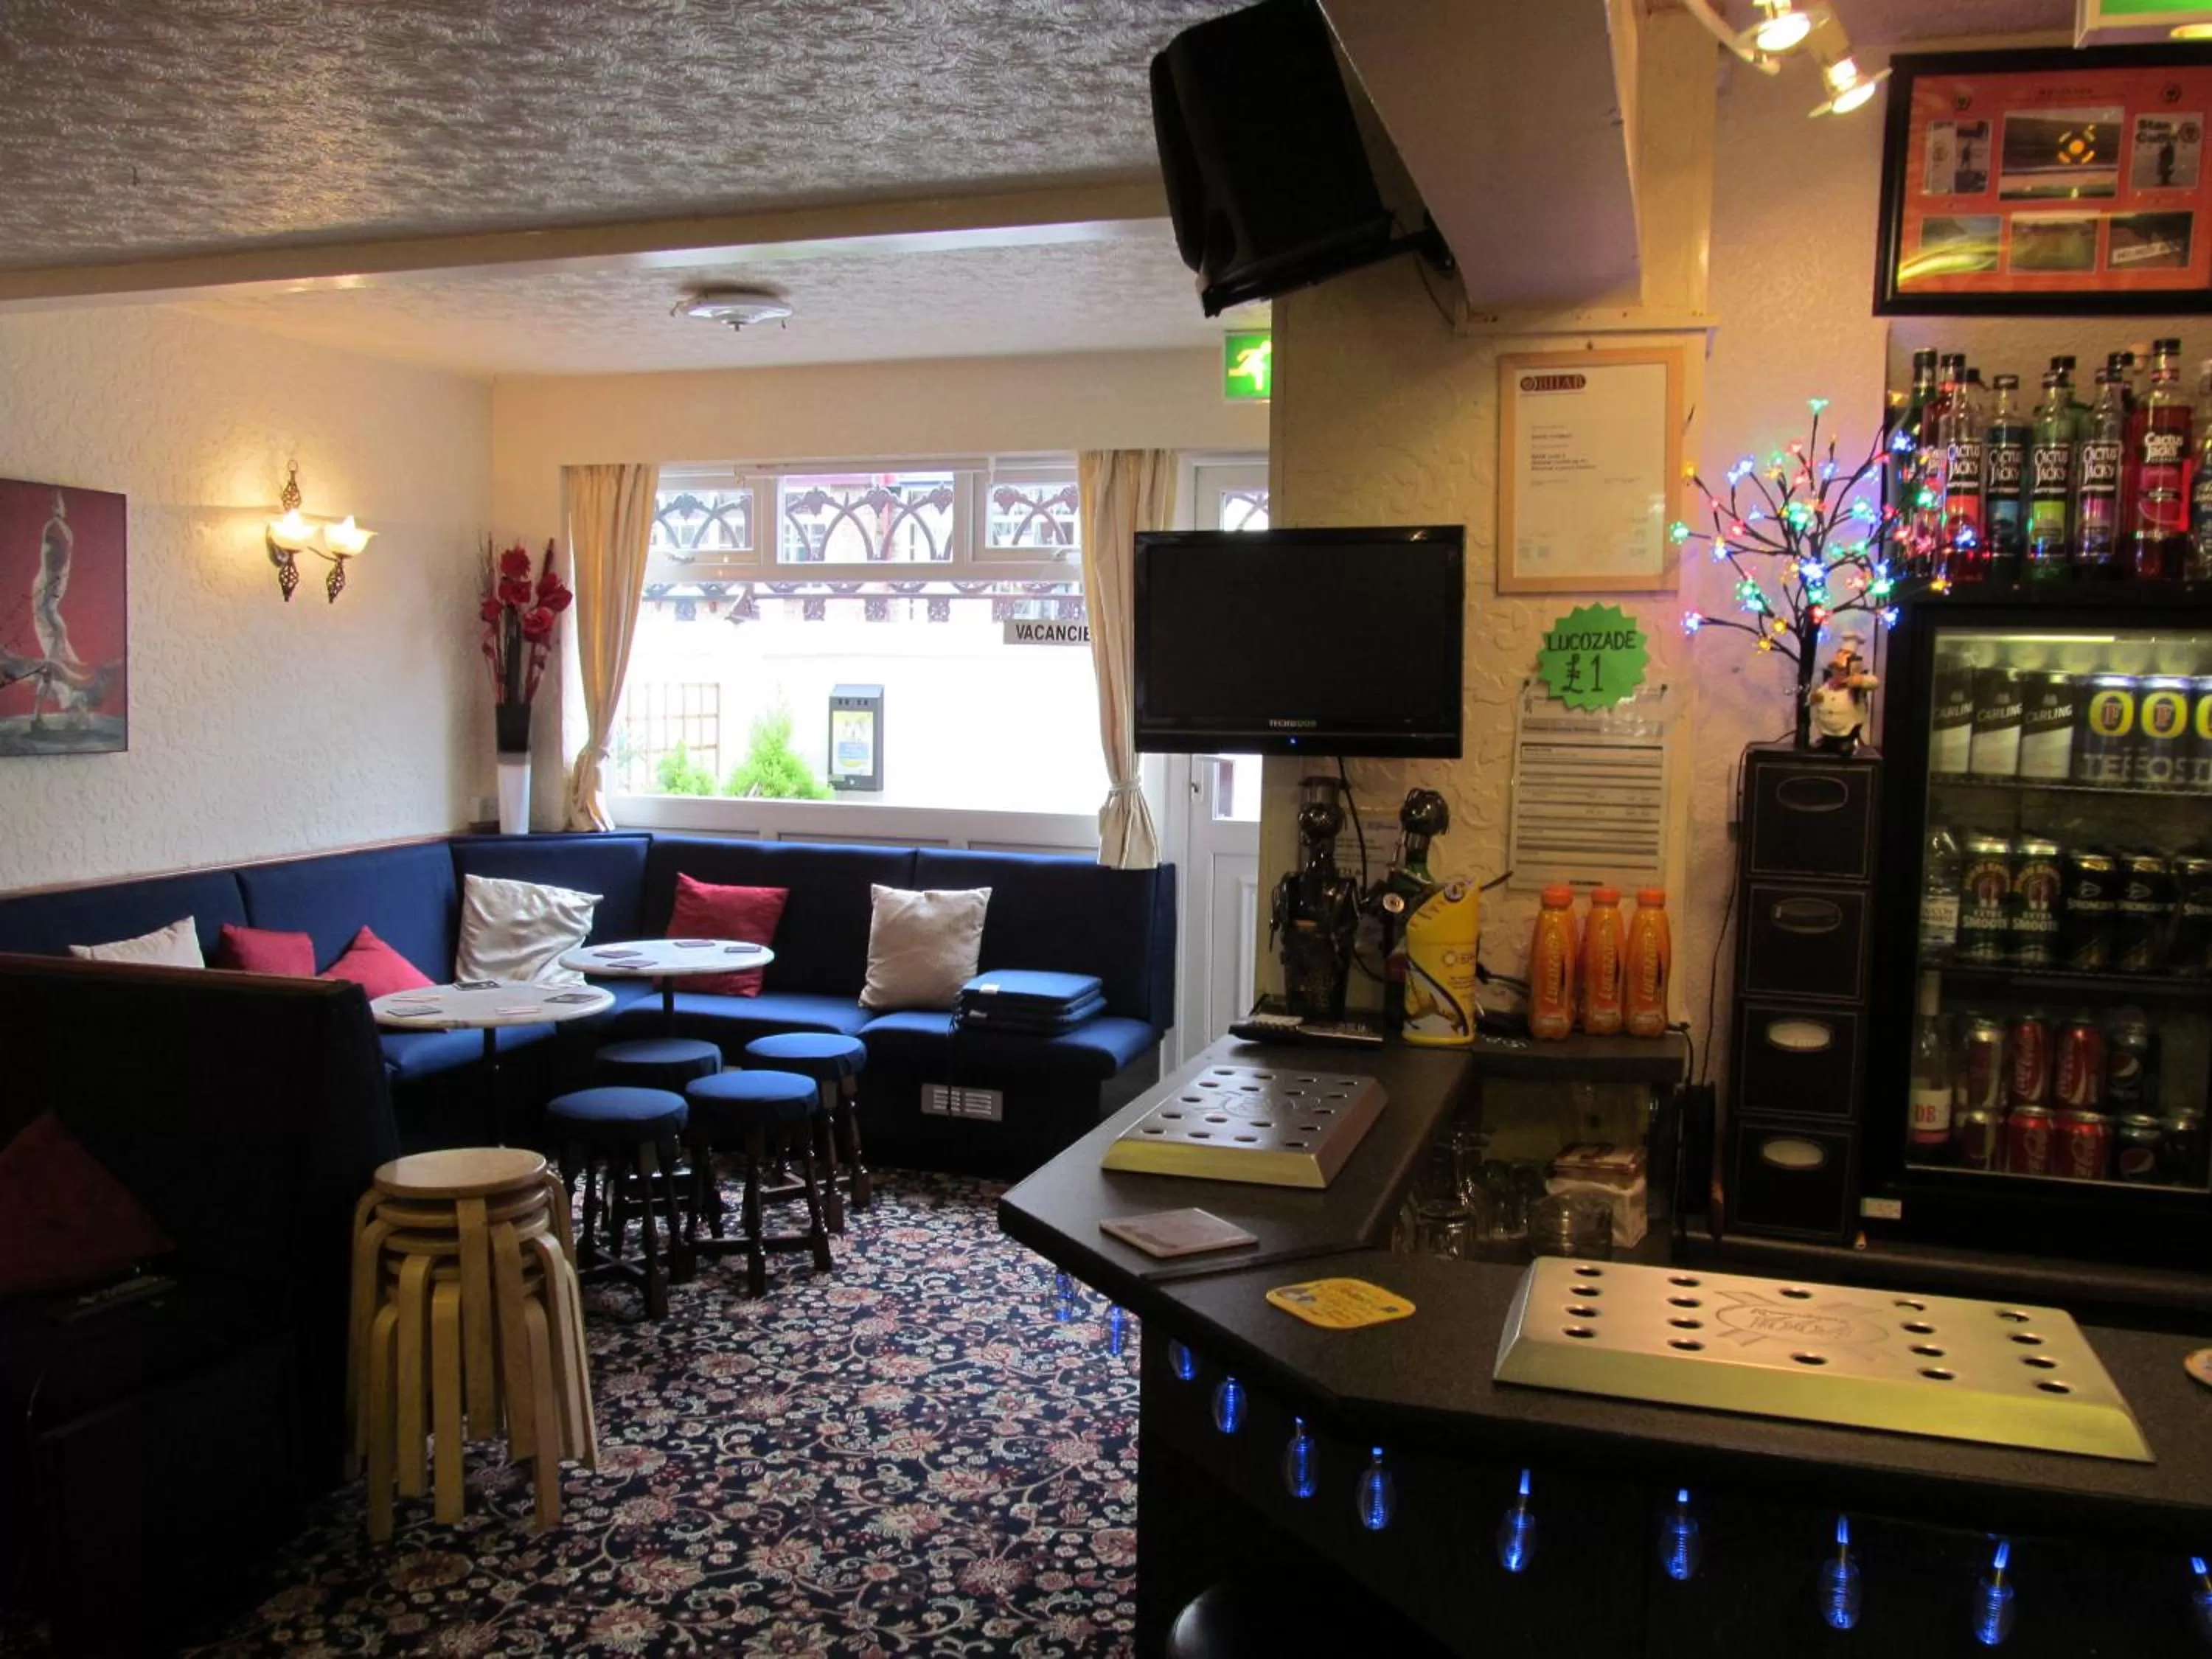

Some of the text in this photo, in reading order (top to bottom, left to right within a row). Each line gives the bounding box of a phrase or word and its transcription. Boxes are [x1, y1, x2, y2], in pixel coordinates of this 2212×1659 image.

[1015, 624, 1091, 642] VACANCIE
[1546, 630, 1637, 652] LUCOZADE
[1561, 653, 1604, 694] £1
[2026, 703, 2074, 723] CARLING
